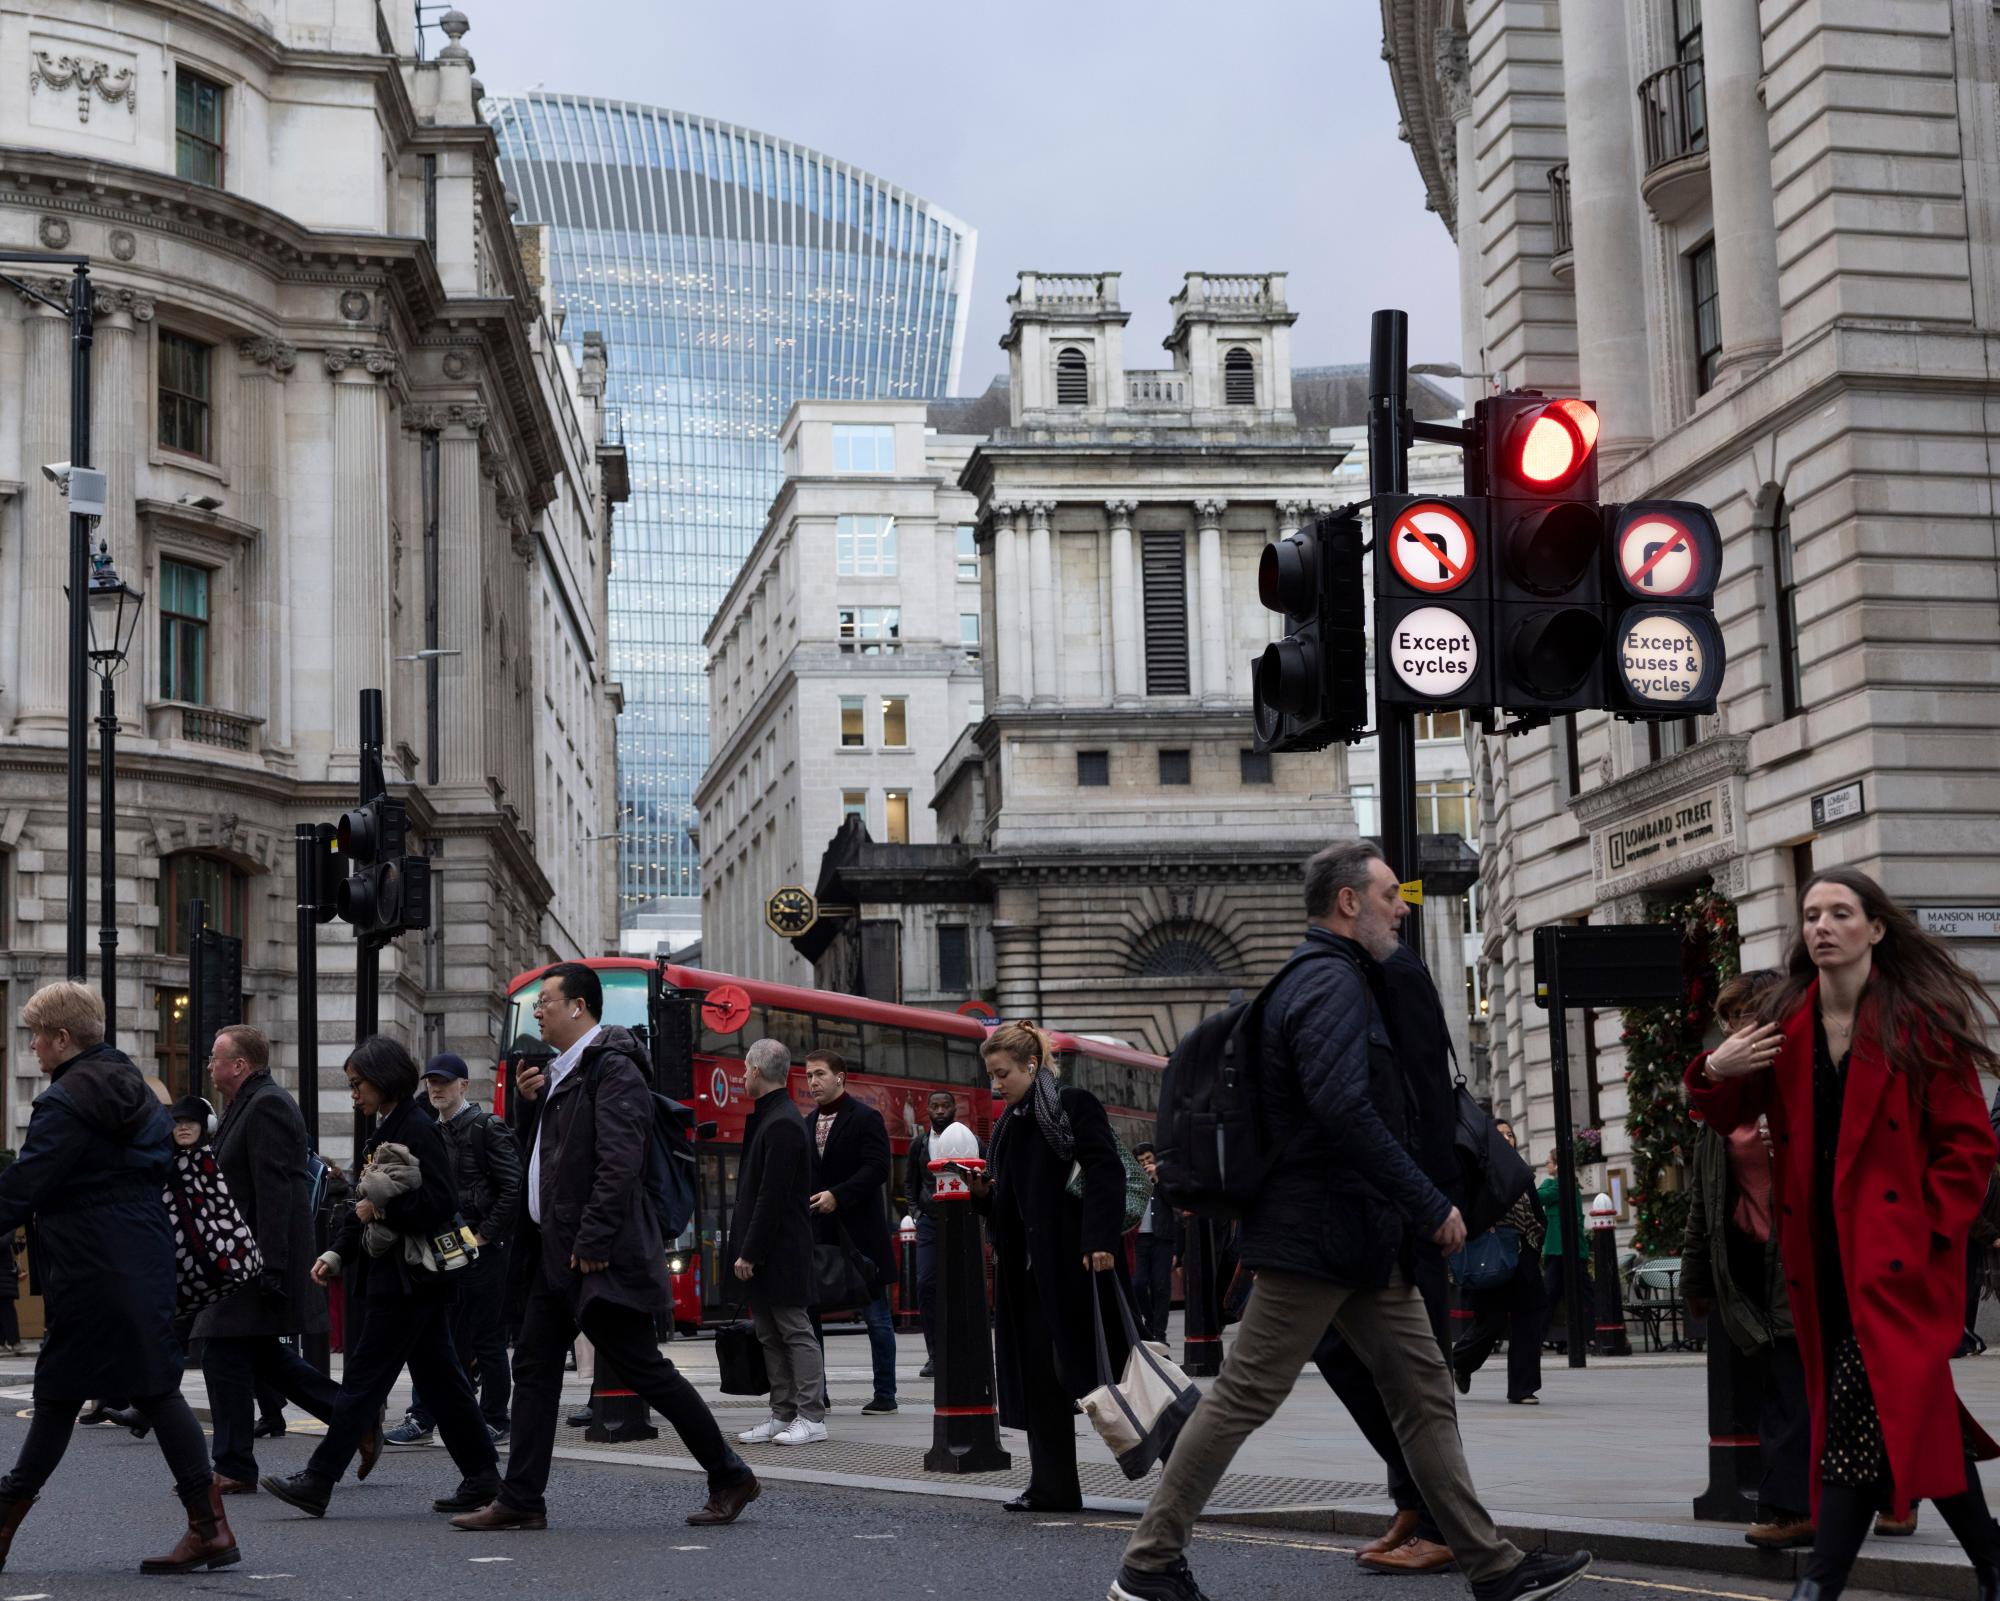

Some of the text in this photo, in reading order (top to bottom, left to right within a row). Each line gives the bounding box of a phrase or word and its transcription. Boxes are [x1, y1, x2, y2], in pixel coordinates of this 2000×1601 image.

[1399, 632, 1470, 654] Except
[1627, 632, 1693, 654] Except
[1403, 656, 1468, 676] cycles
[1623, 653, 1698, 672] buses &
[1630, 675, 1691, 694] cycles
[1625, 816, 1673, 847] LOMBARD
[1675, 799, 1713, 830] STREET
[1927, 912, 2000, 922] MANSION HOU
[1928, 923, 1958, 933] PLACE
